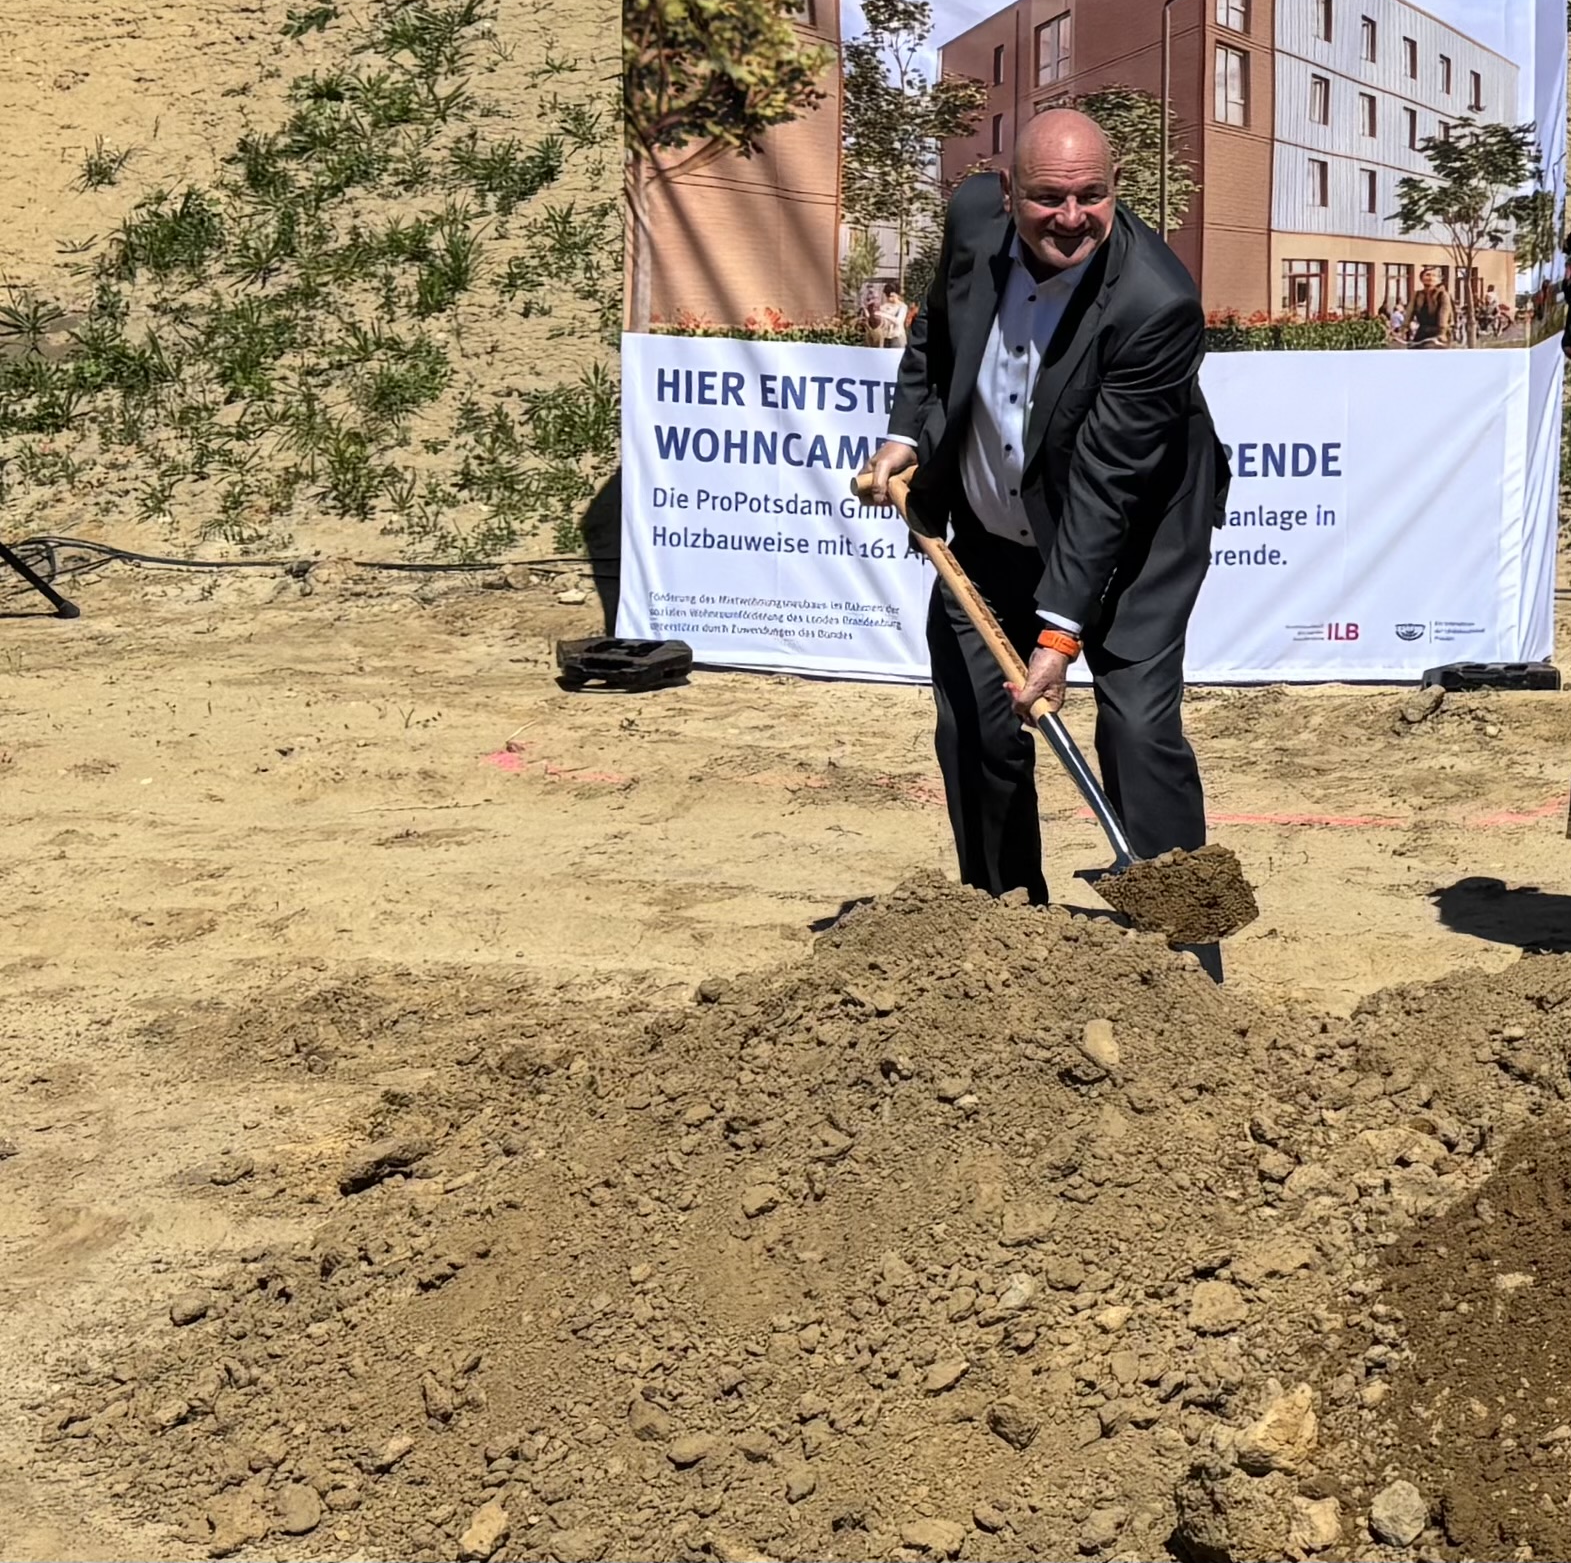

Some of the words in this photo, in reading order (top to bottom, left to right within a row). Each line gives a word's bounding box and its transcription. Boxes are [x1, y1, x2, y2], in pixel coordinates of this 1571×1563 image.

[656, 367, 746, 407] HIER
[652, 487, 689, 509] Die
[696, 488, 832, 517] ProPotsdam
[1222, 504, 1308, 532] anlage
[1315, 503, 1336, 527] in
[652, 525, 810, 554] Holzbauweise
[817, 534, 853, 557] mit
[859, 538, 897, 560] 161
[1211, 543, 1288, 566] rende.
[1327, 622, 1359, 641] ILB
